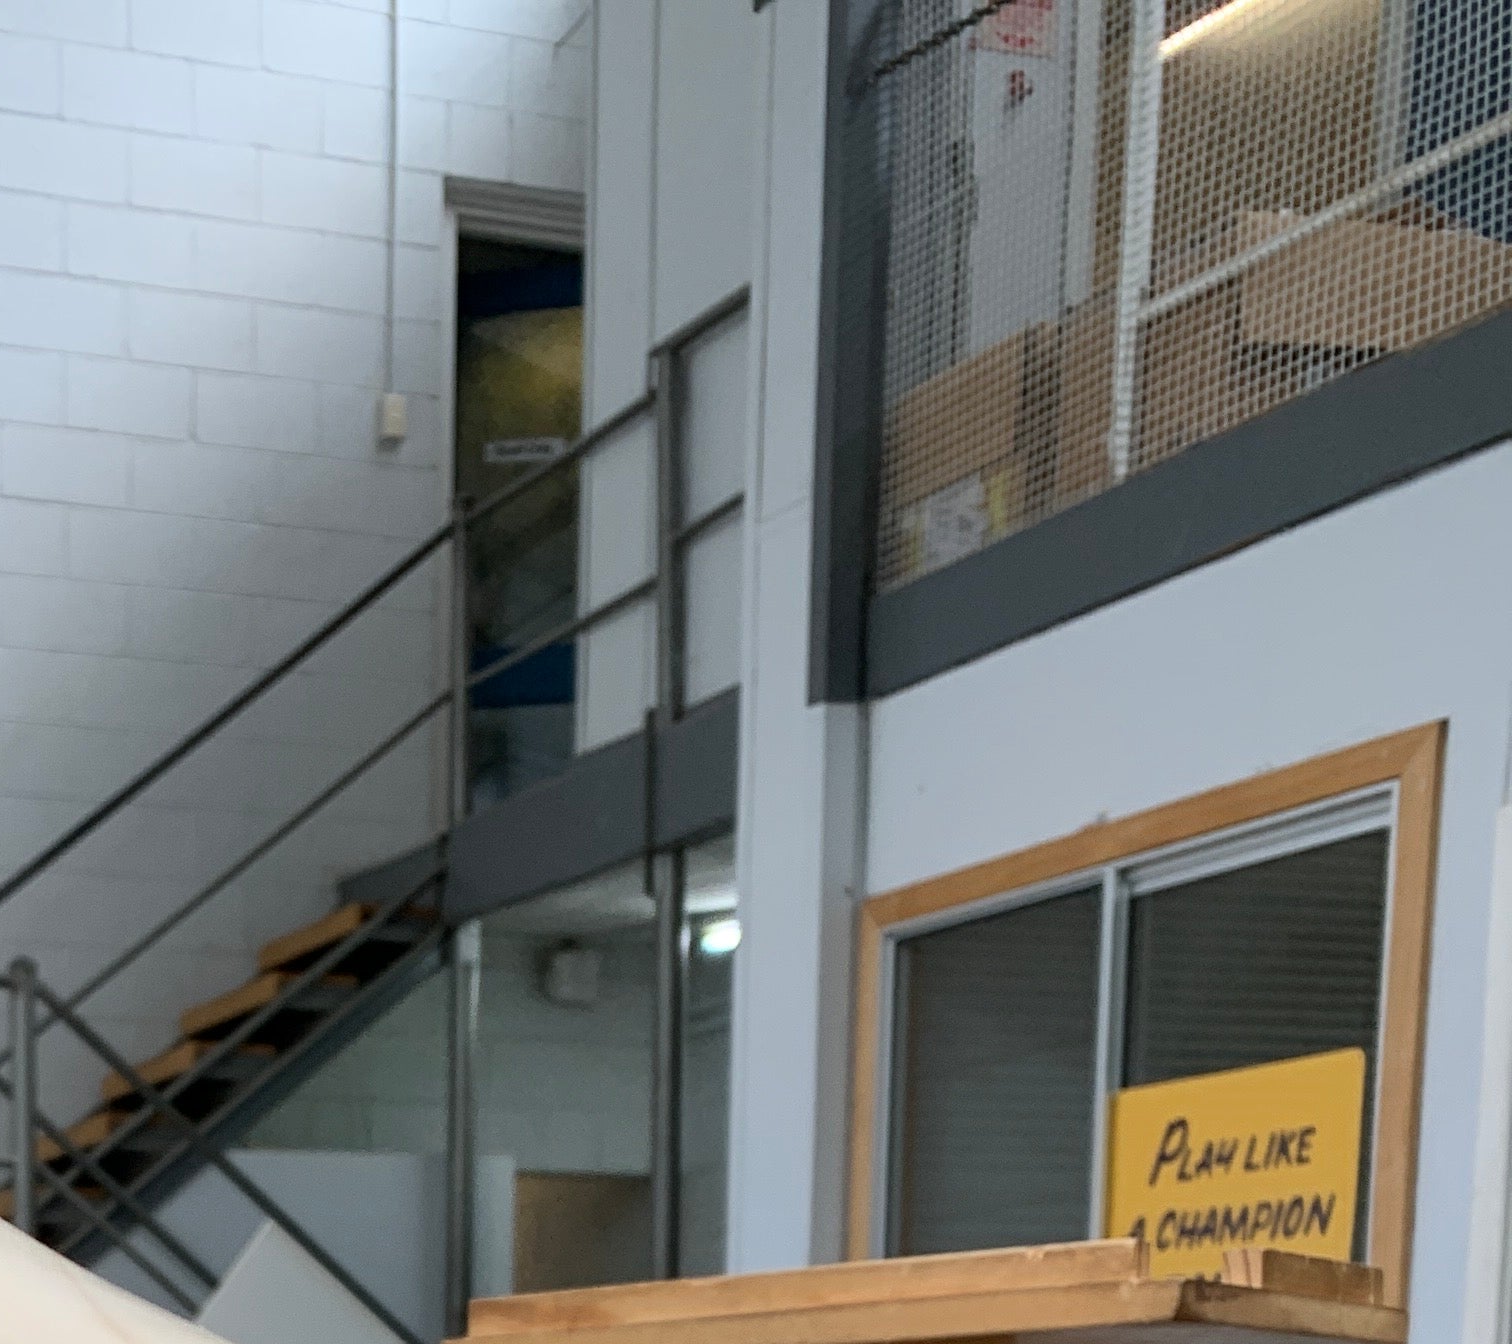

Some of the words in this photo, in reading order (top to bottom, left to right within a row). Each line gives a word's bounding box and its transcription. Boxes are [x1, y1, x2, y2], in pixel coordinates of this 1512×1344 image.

[1149, 1116, 1239, 1187] PLAY
[1243, 1125, 1317, 1173] LIKE
[1156, 1192, 1337, 1251] CHAMPION
